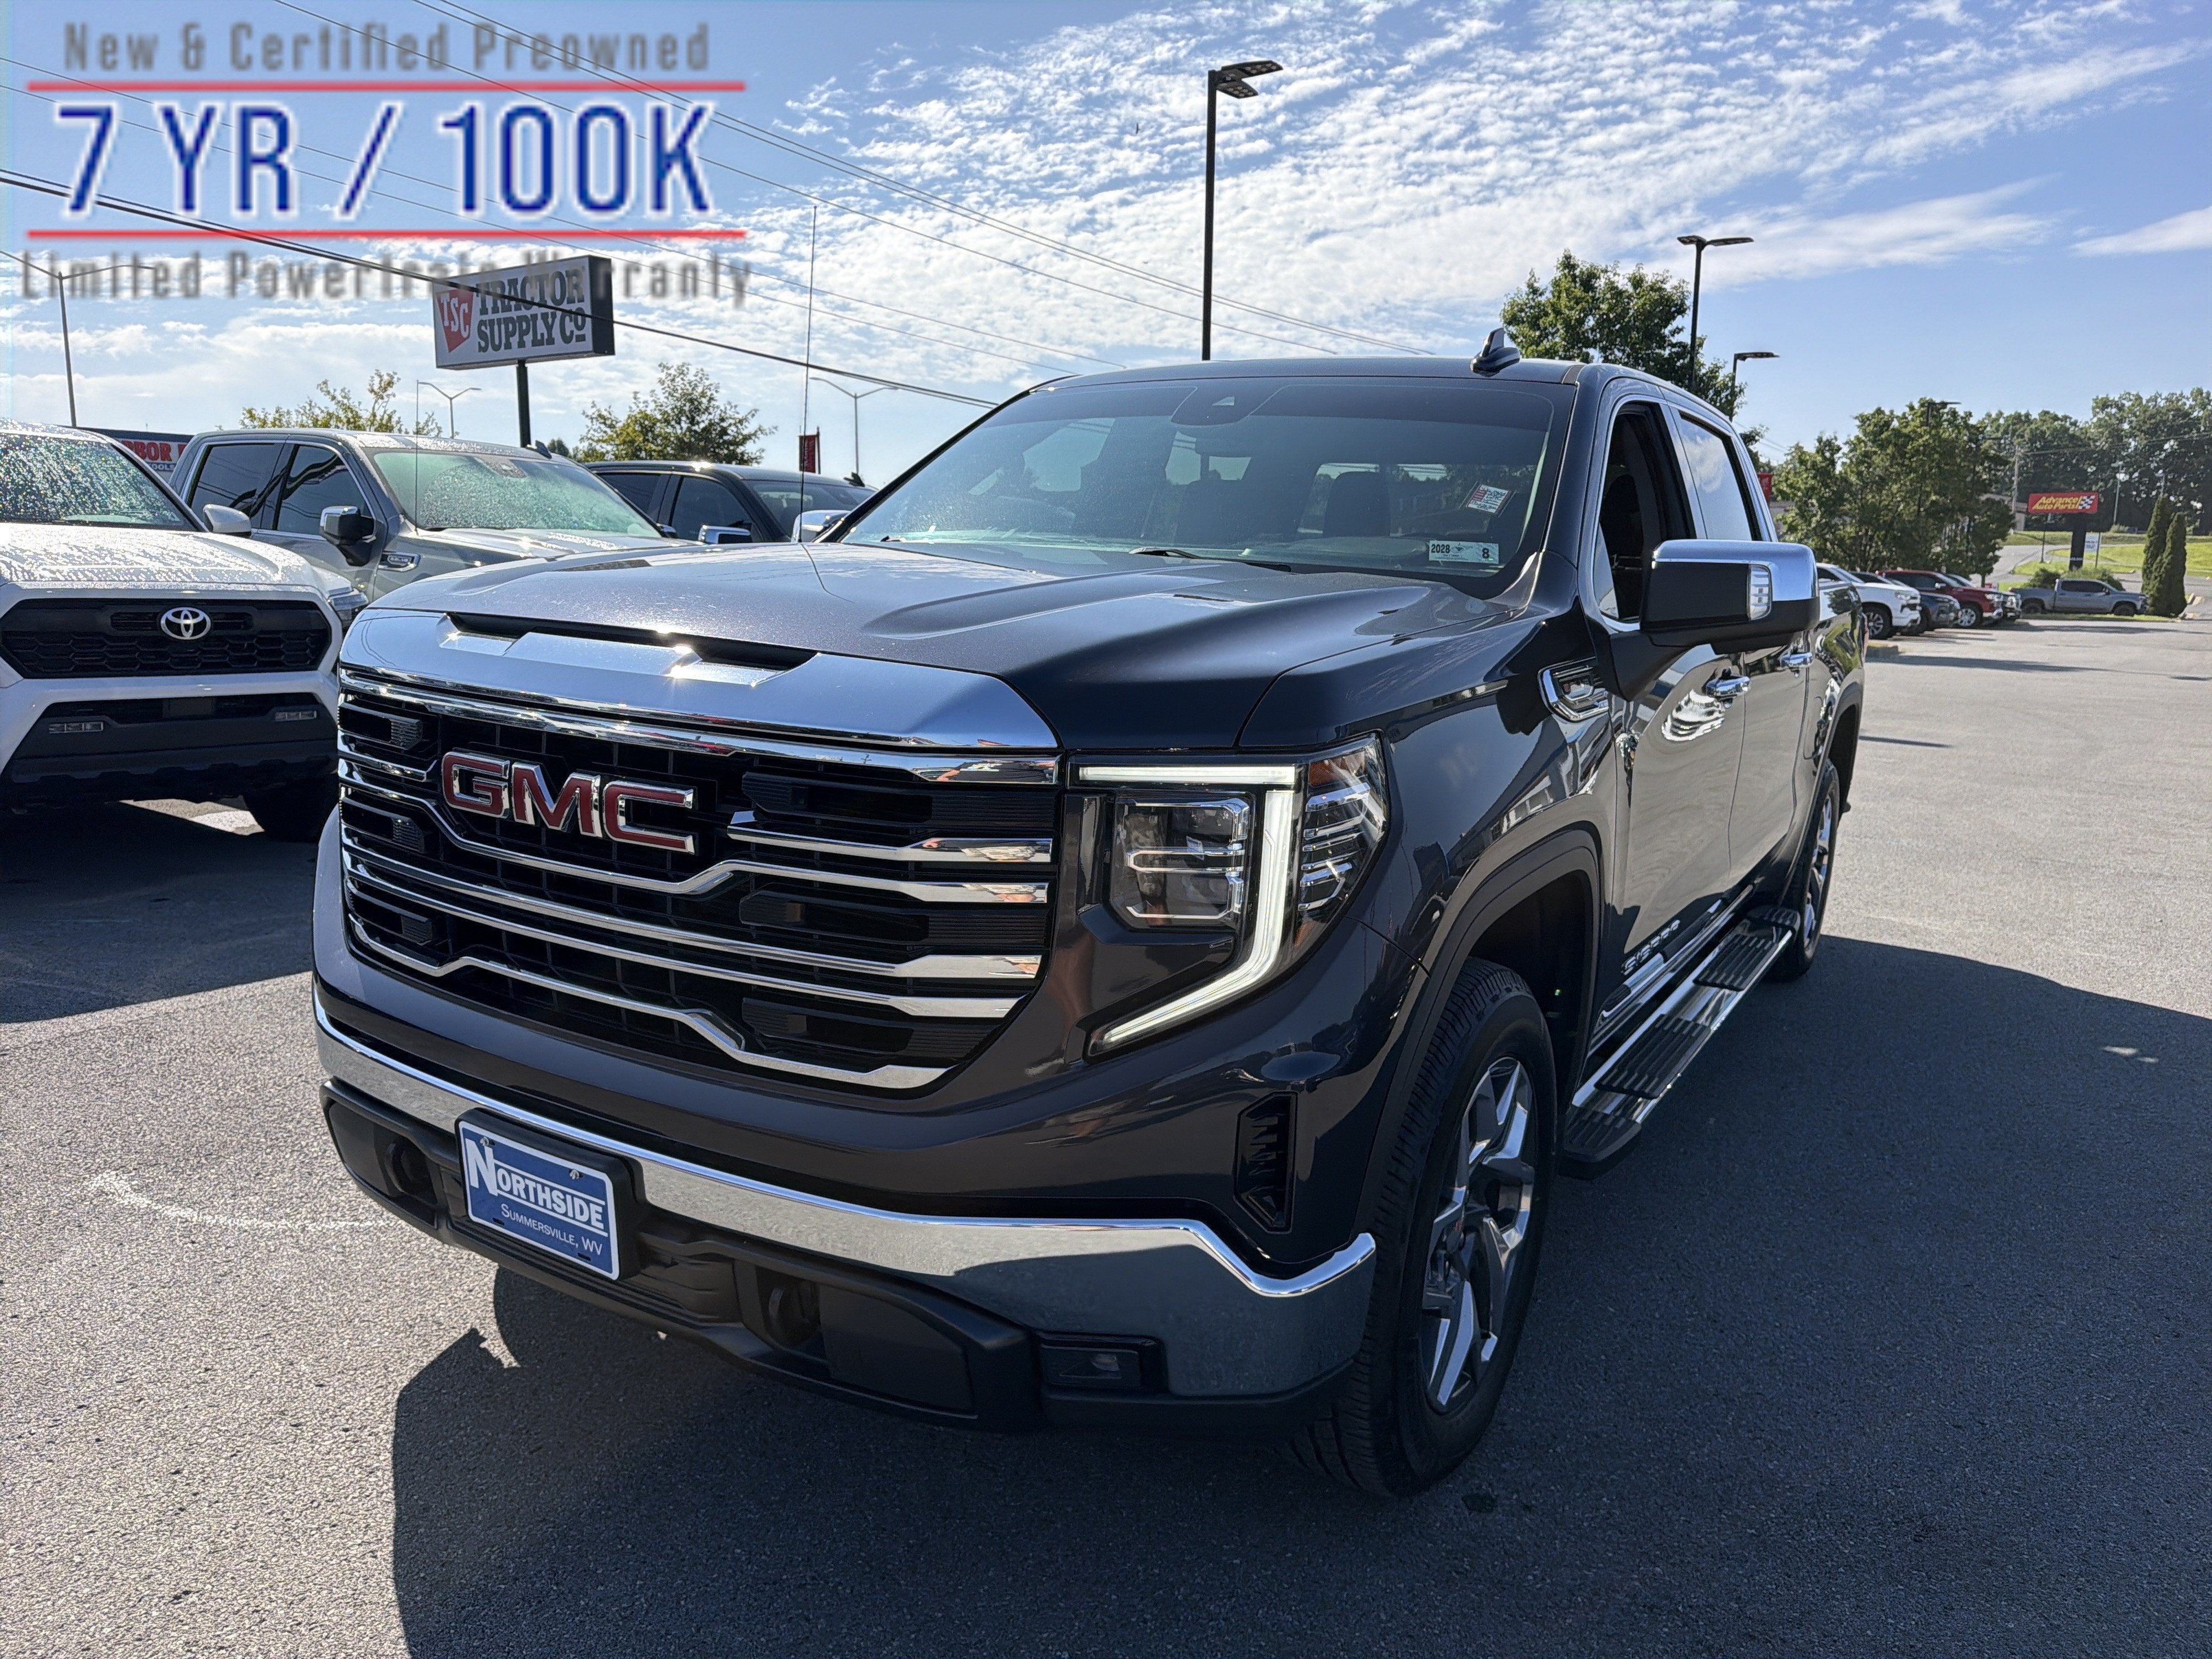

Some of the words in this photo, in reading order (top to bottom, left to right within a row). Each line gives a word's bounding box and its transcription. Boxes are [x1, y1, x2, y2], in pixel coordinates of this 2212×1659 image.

[476, 268, 585, 315] TRACTOR
[439, 297, 469, 338] TSC
[477, 311, 557, 353] SUPPLY
[1431, 544, 1451, 554] 2028
[1482, 548, 1490, 559] 8
[442, 751, 695, 854] GMC
[582, 1236, 603, 1255] WV
